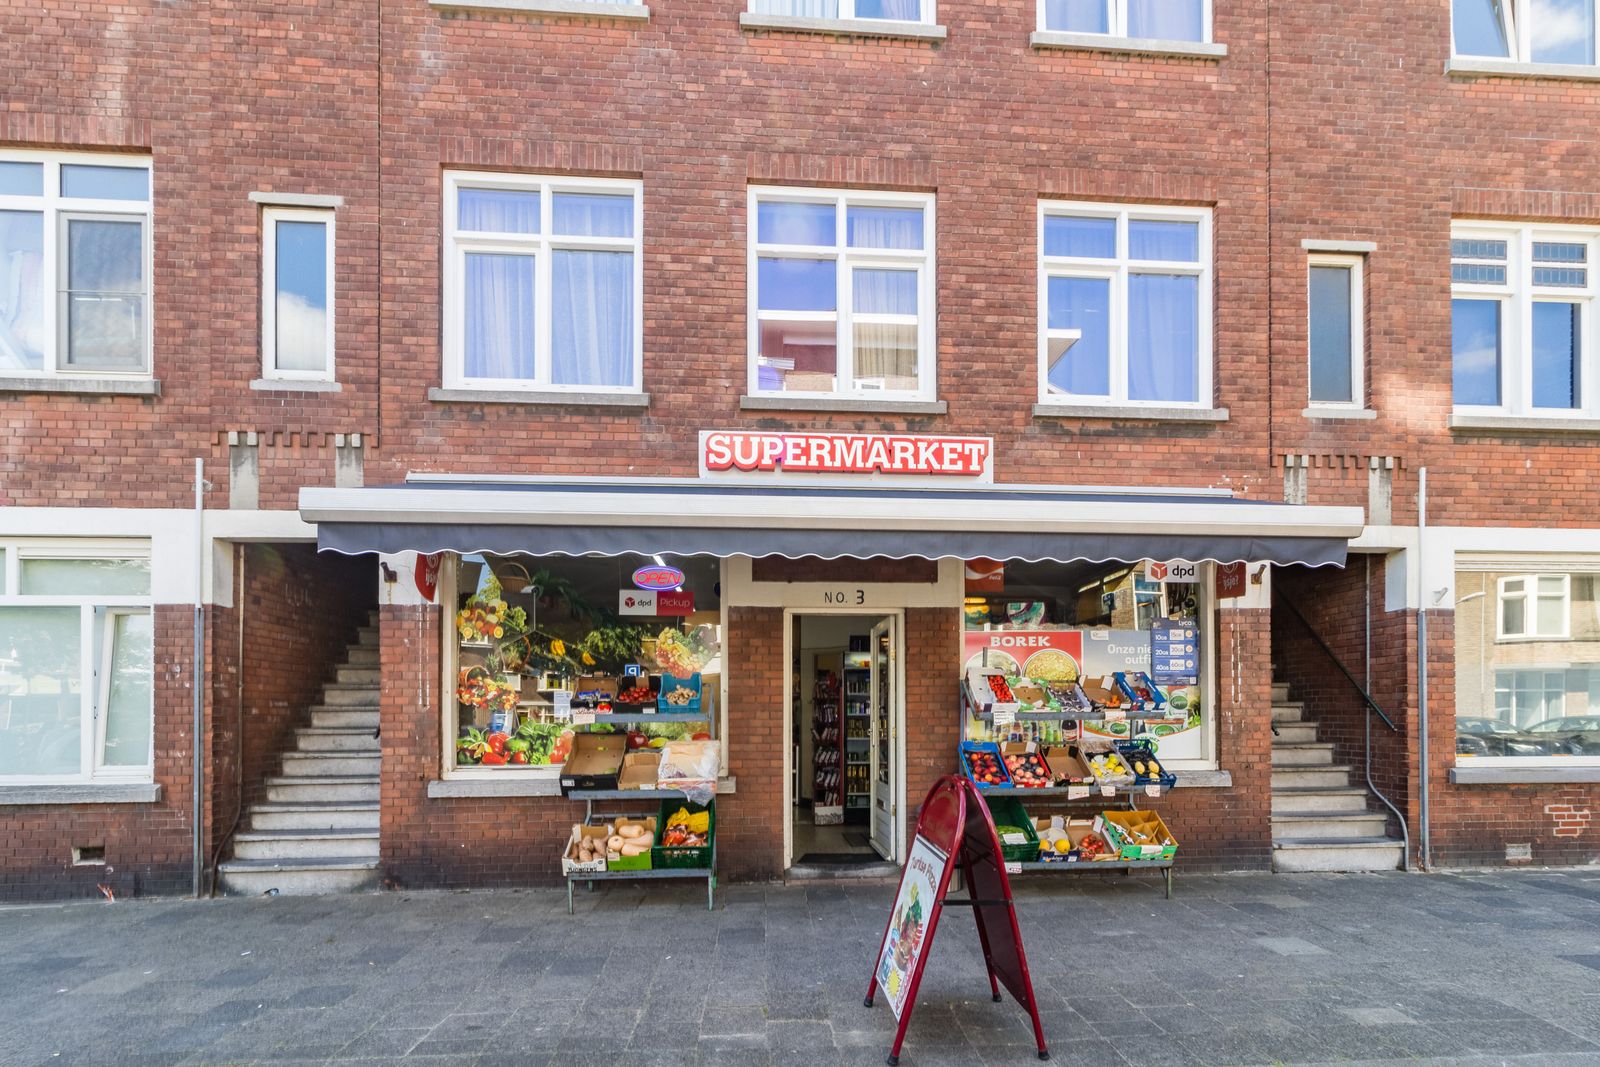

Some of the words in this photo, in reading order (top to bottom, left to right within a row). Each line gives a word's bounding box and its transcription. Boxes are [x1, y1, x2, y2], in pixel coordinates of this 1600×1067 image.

[707, 433, 987, 473] SUPERMARKET
[635, 571, 682, 586] OPEN
[1172, 565, 1195, 579] dpd
[637, 598, 652, 608] dpd
[660, 598, 691, 610] Pickup
[824, 592, 848, 604] NO.
[855, 590, 865, 605] 3
[990, 636, 1050, 648] BOREK
[1107, 644, 1135, 654] Onze
